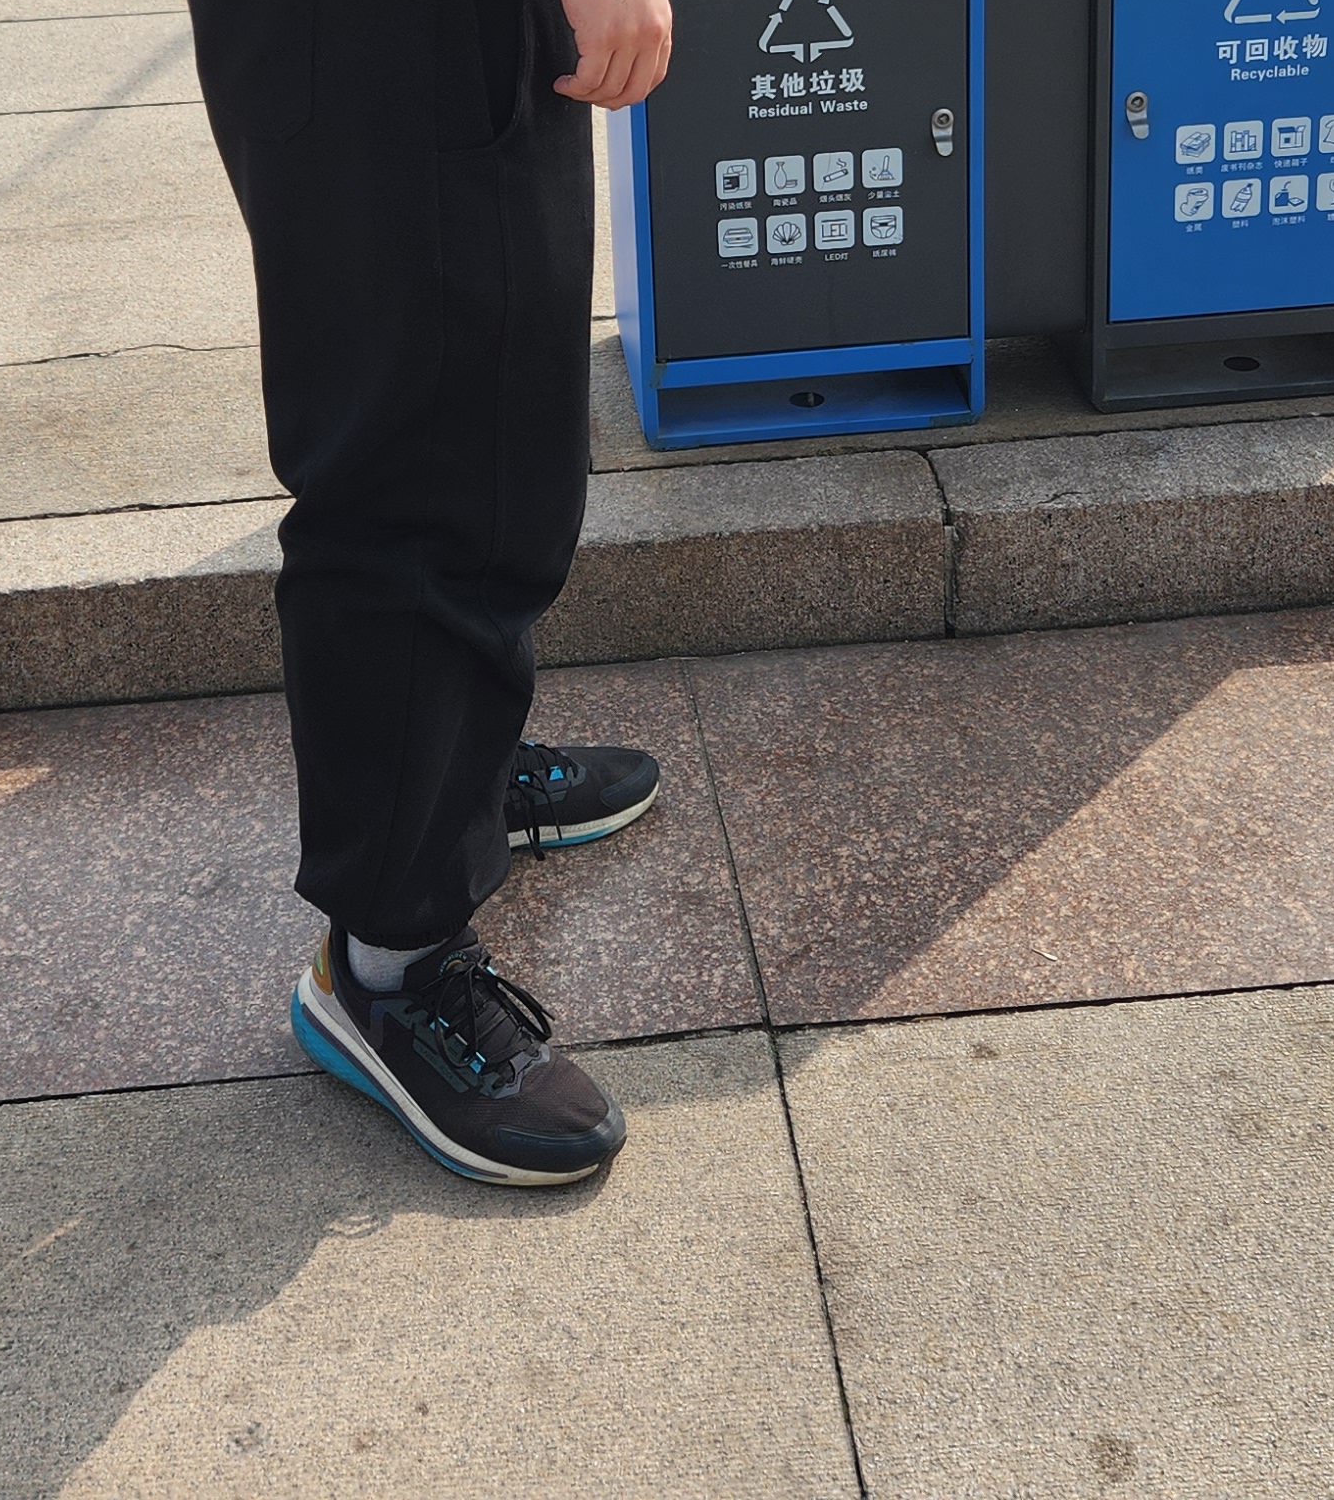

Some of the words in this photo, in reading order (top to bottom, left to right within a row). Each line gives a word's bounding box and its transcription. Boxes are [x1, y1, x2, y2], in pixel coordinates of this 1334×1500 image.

[1216, 34, 1328, 64] 可回收物
[750, 68, 866, 100] 其他垃圾
[1230, 65, 1310, 82] Recyclable
[748, 102, 813, 120] Residual
[820, 99, 868, 114] Waste
[824, 252, 849, 262] LED灯
